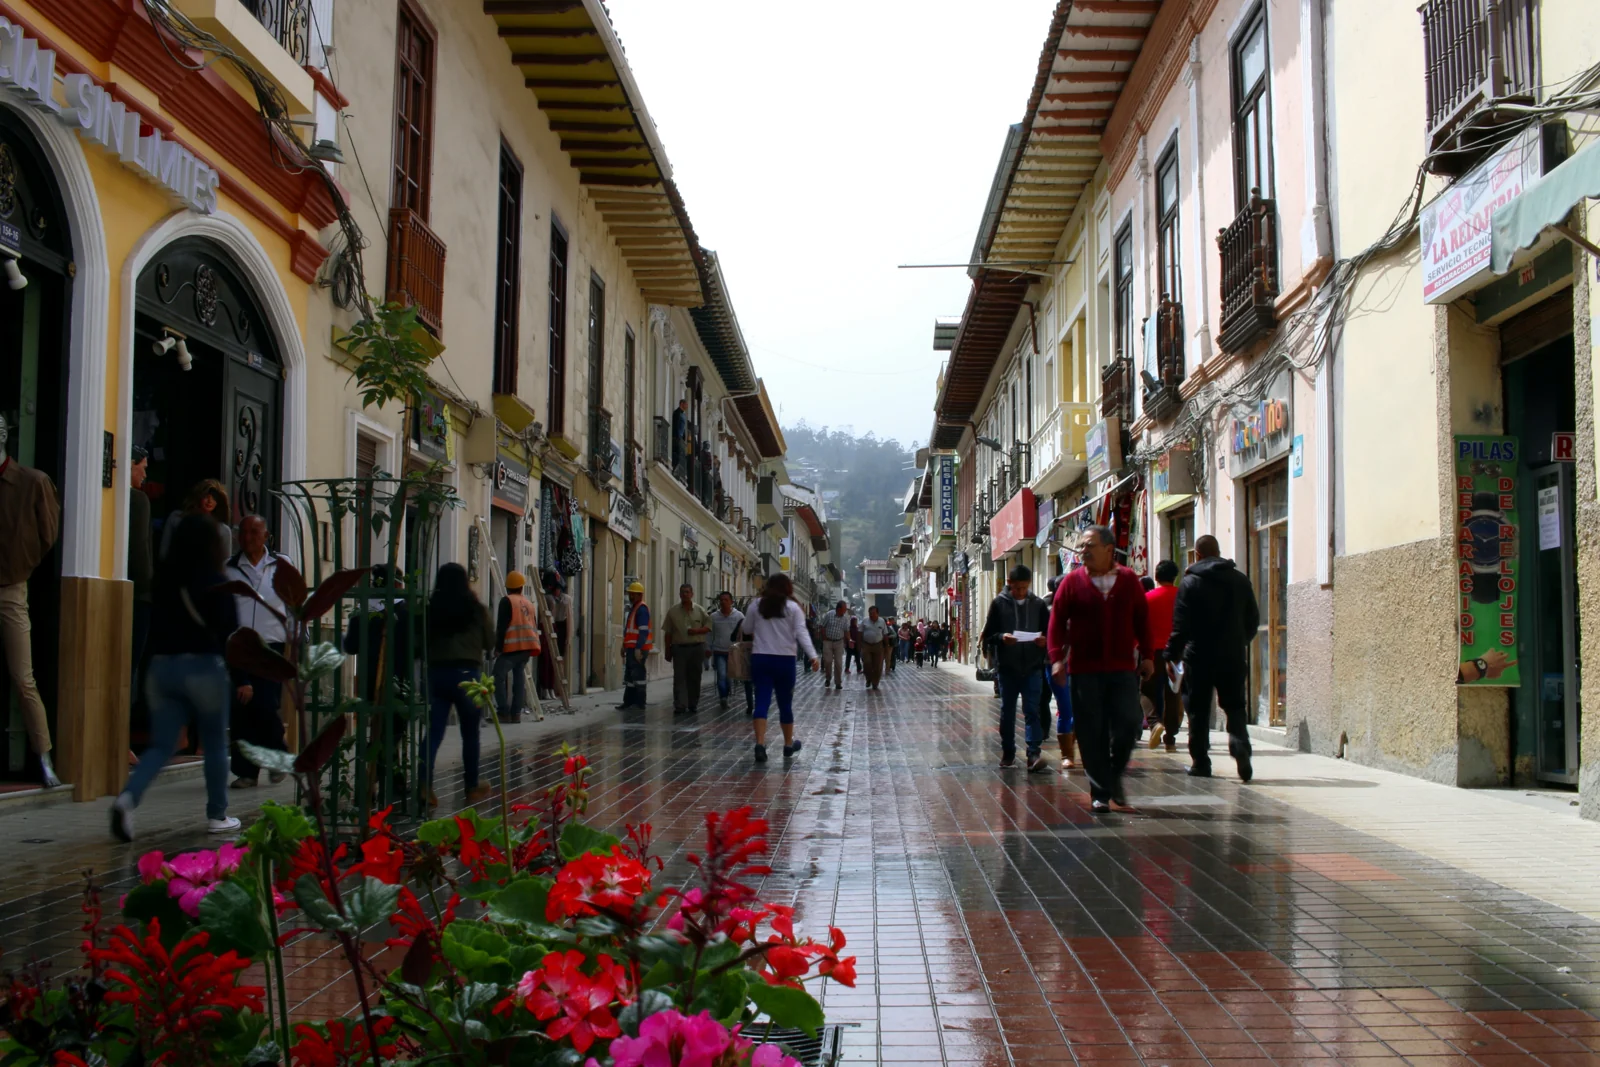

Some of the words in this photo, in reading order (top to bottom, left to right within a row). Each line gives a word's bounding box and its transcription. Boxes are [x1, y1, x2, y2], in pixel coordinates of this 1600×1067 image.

[1431, 237, 1448, 265] LA
[1427, 254, 1462, 282] SERVICIO
[1459, 441, 1514, 461] PILAS
[942, 460, 952, 530] RESIDENCIAL
[1498, 477, 1514, 509] DE
[1458, 475, 1474, 645] REPARACION
[1498, 523, 1515, 645] RELOJES
